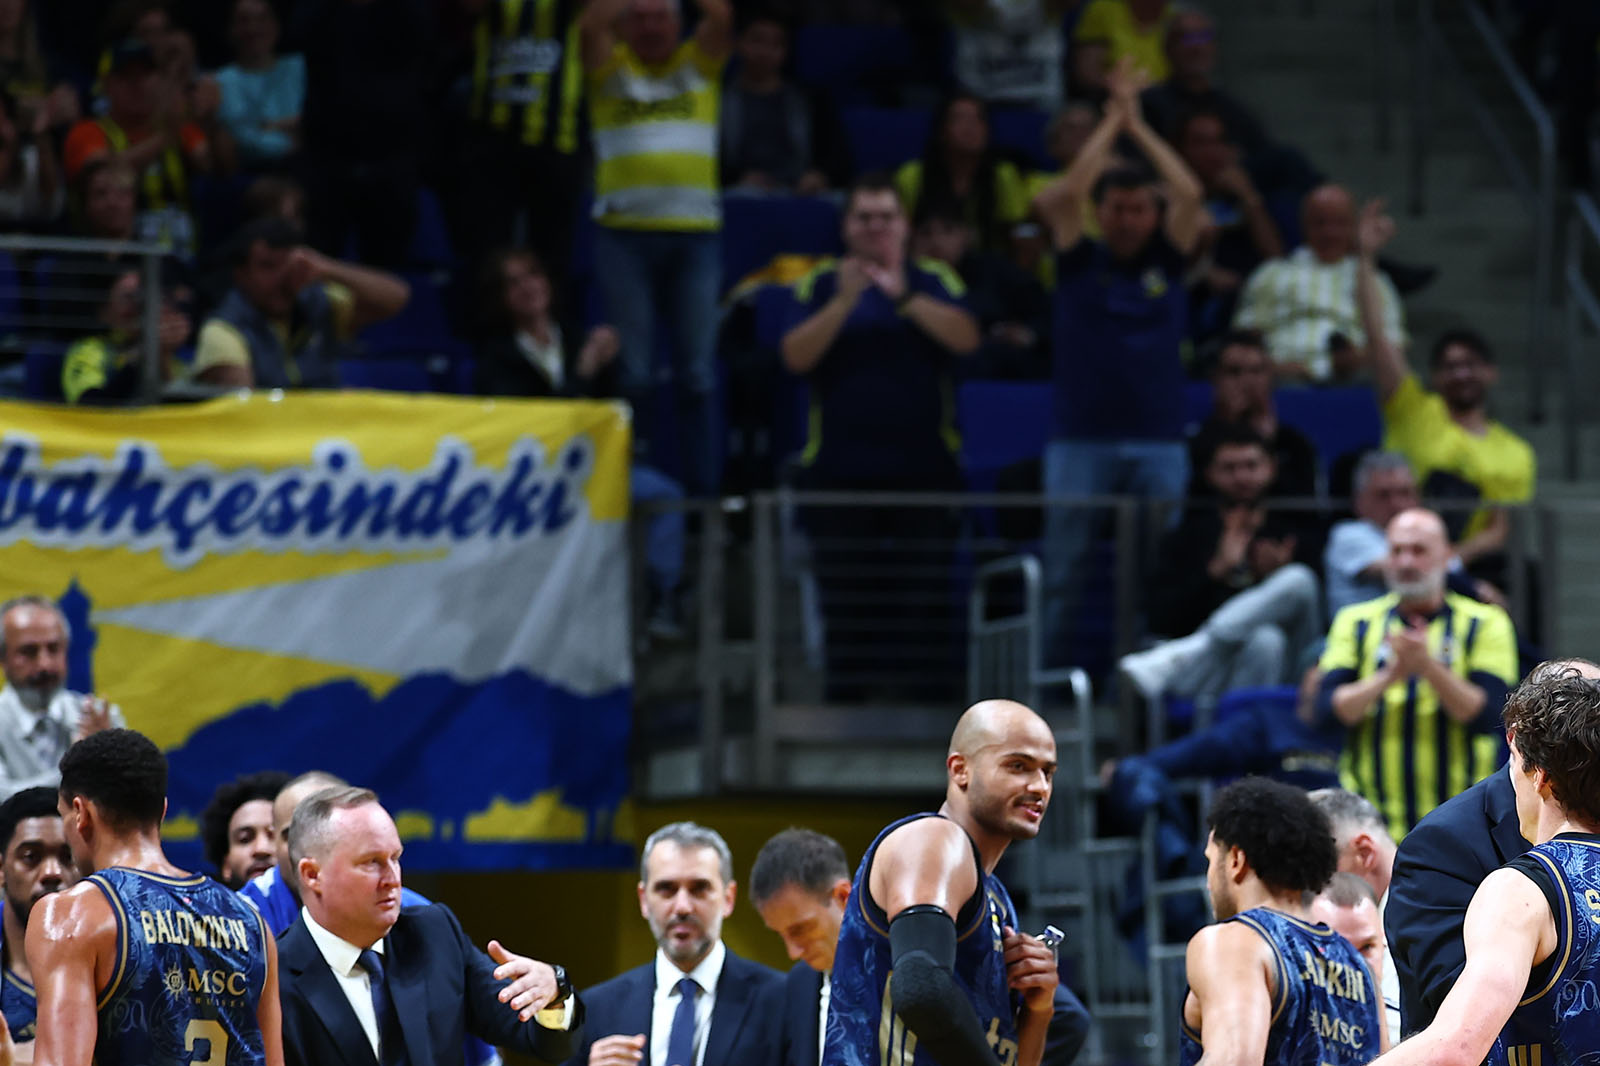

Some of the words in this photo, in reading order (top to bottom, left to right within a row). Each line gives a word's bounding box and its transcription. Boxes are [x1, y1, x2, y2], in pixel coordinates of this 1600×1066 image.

[140, 910, 231, 949] BALDWIN
[187, 968, 246, 995] MSC
[1321, 1013, 1364, 1049] MSC
